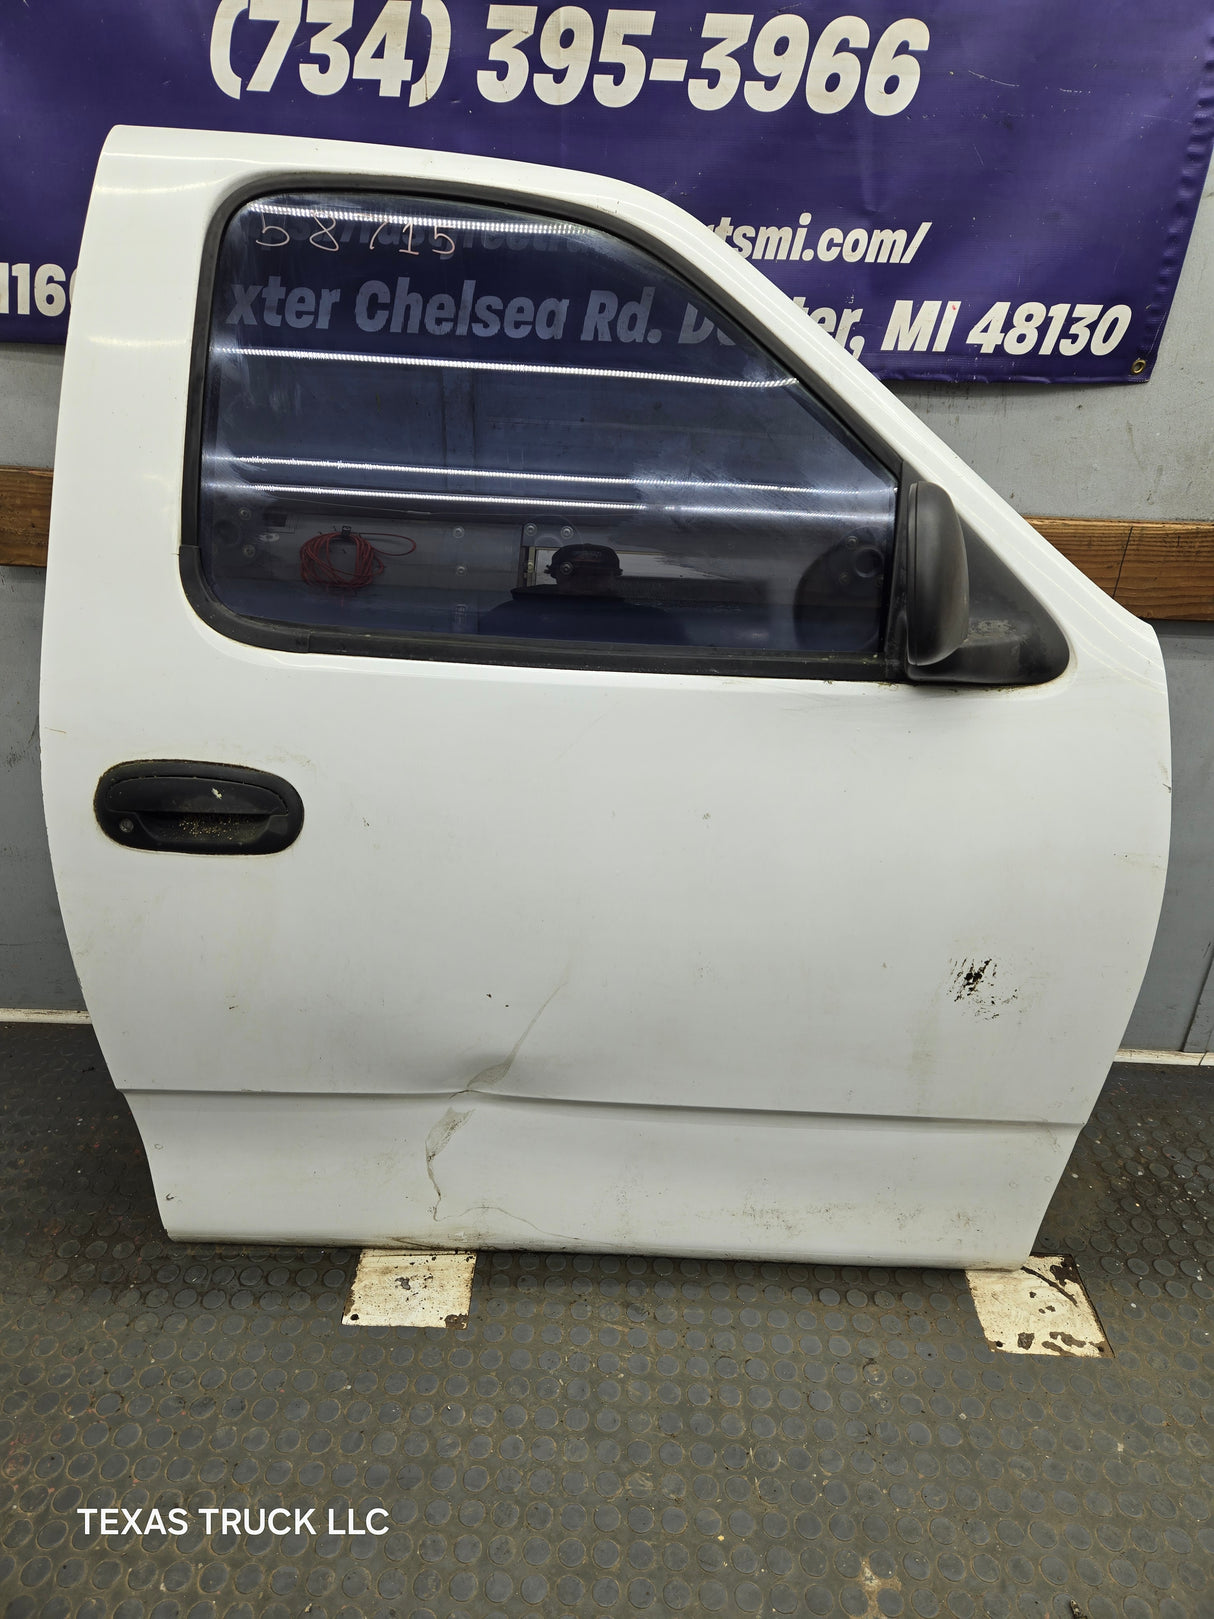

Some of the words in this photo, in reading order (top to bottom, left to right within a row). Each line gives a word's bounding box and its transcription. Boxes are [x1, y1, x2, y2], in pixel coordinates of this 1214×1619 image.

[209, 0, 452, 107] (734)
[476, 4, 930, 117] 395-3966
[0, 262, 79, 317] 116
[225, 275, 341, 330] xter
[354, 276, 570, 340] Chelsea
[580, 286, 663, 345] Rd.
[880, 300, 962, 353] MI
[966, 301, 1132, 356] 48130
